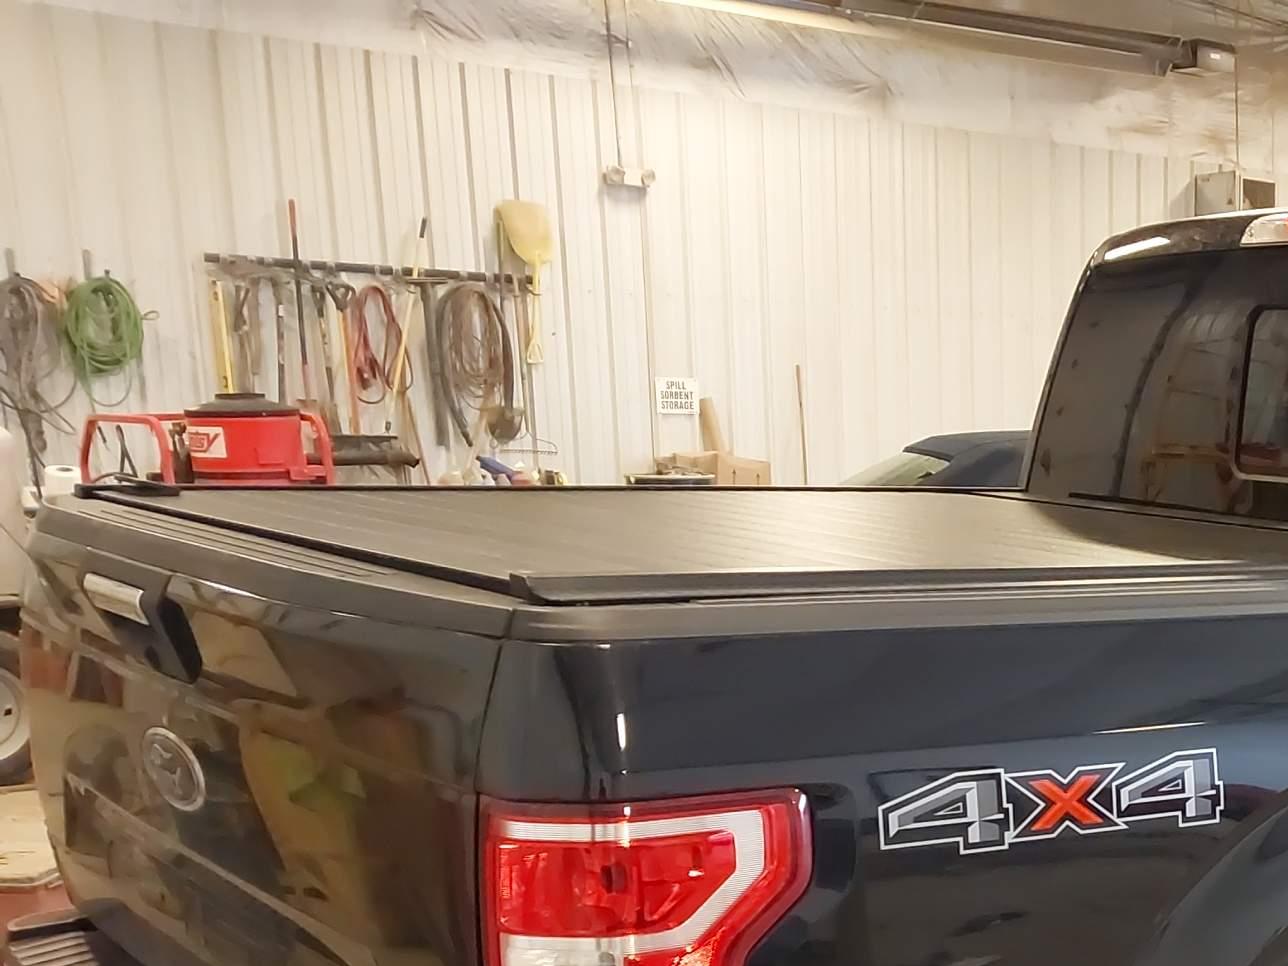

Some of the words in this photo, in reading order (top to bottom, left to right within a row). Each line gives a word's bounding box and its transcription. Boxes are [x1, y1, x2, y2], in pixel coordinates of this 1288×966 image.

[665, 381, 687, 390] SPILL
[660, 391, 694, 400] SORBENT
[661, 401, 694, 410] STORAGE
